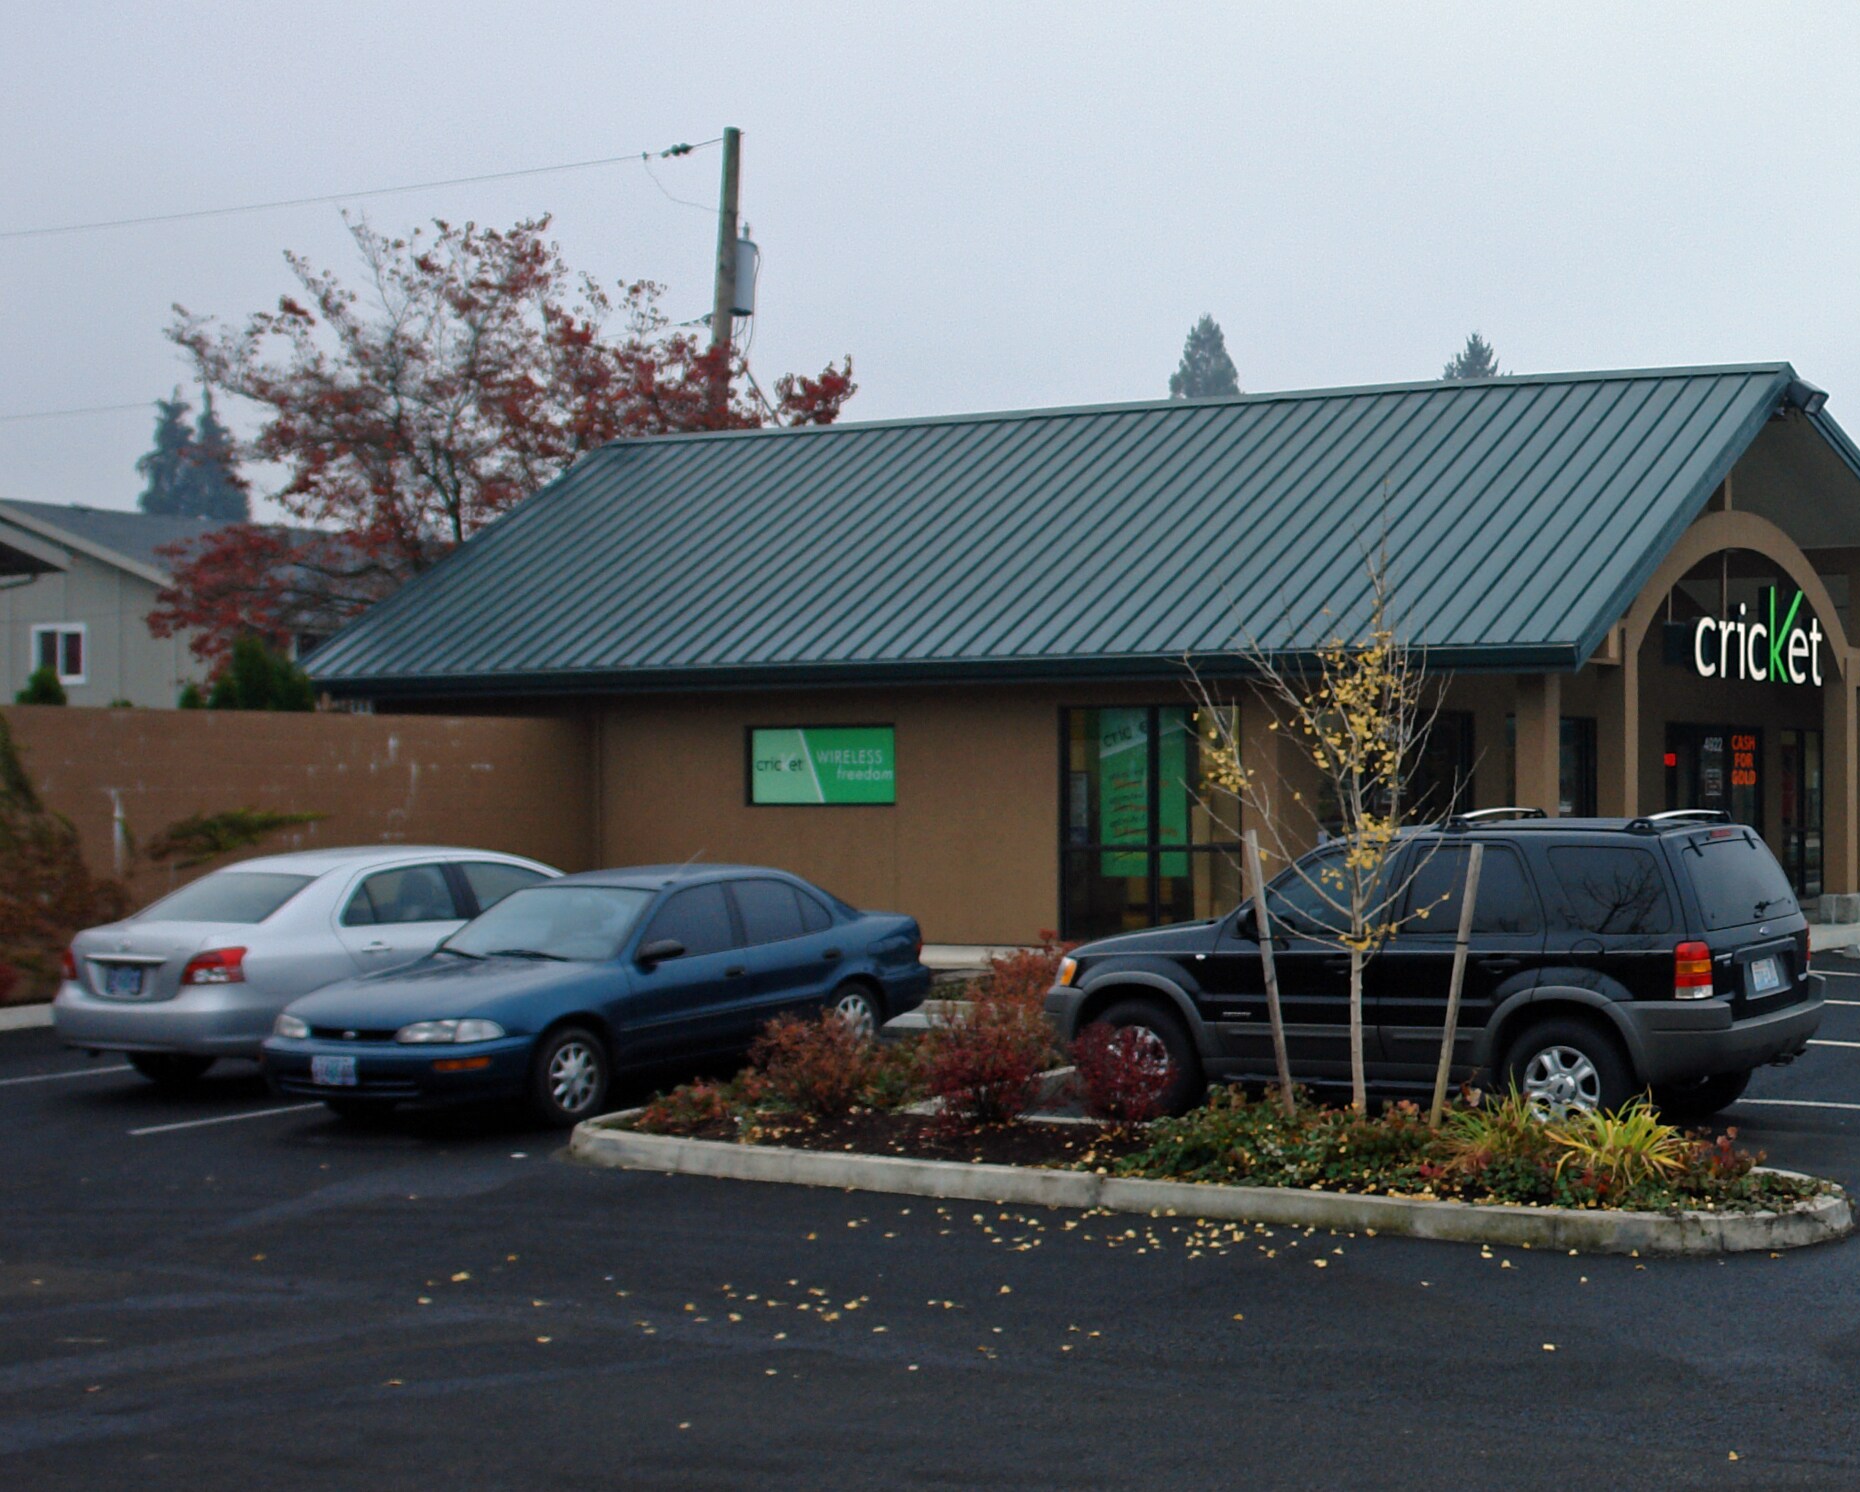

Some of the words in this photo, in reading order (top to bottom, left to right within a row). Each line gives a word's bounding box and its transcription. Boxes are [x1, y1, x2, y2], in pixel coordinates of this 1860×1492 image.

[1731, 735, 1756, 751] CASH
[816, 749, 883, 765] WIRELESS
[1734, 752, 1754, 768] FOR
[836, 763, 894, 781] freedom
[1731, 769, 1757, 785] GOLD
